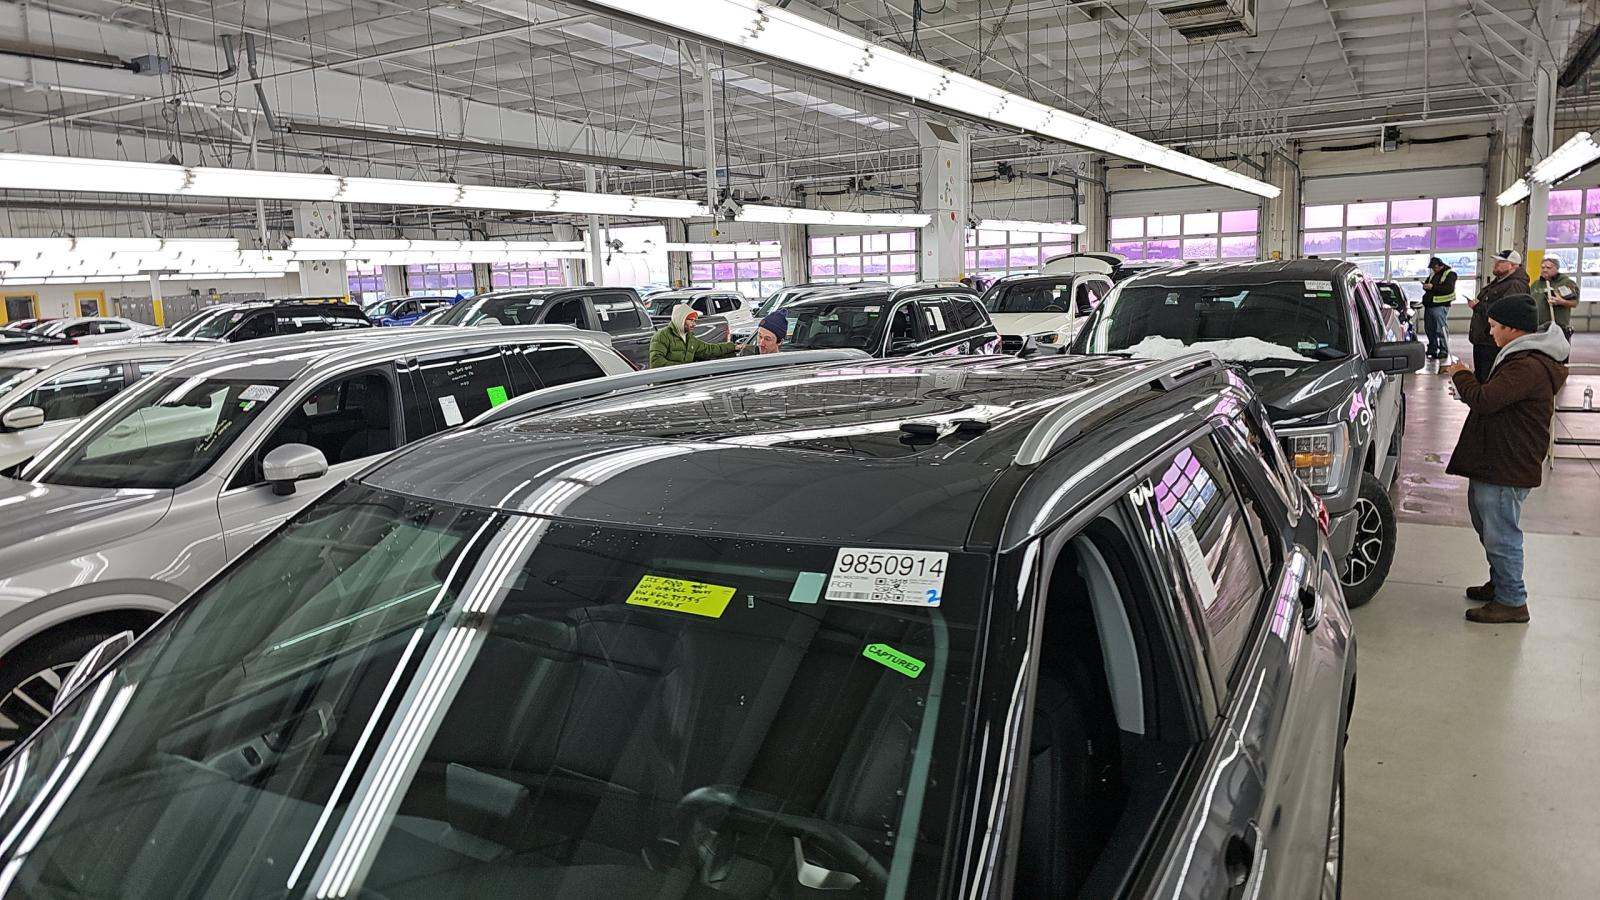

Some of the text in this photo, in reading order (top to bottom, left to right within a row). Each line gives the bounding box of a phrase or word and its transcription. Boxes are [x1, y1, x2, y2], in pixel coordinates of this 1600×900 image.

[839, 553, 944, 577] 9850914
[925, 589, 940, 604] 2
[868, 645, 920, 672] CAPTURED
